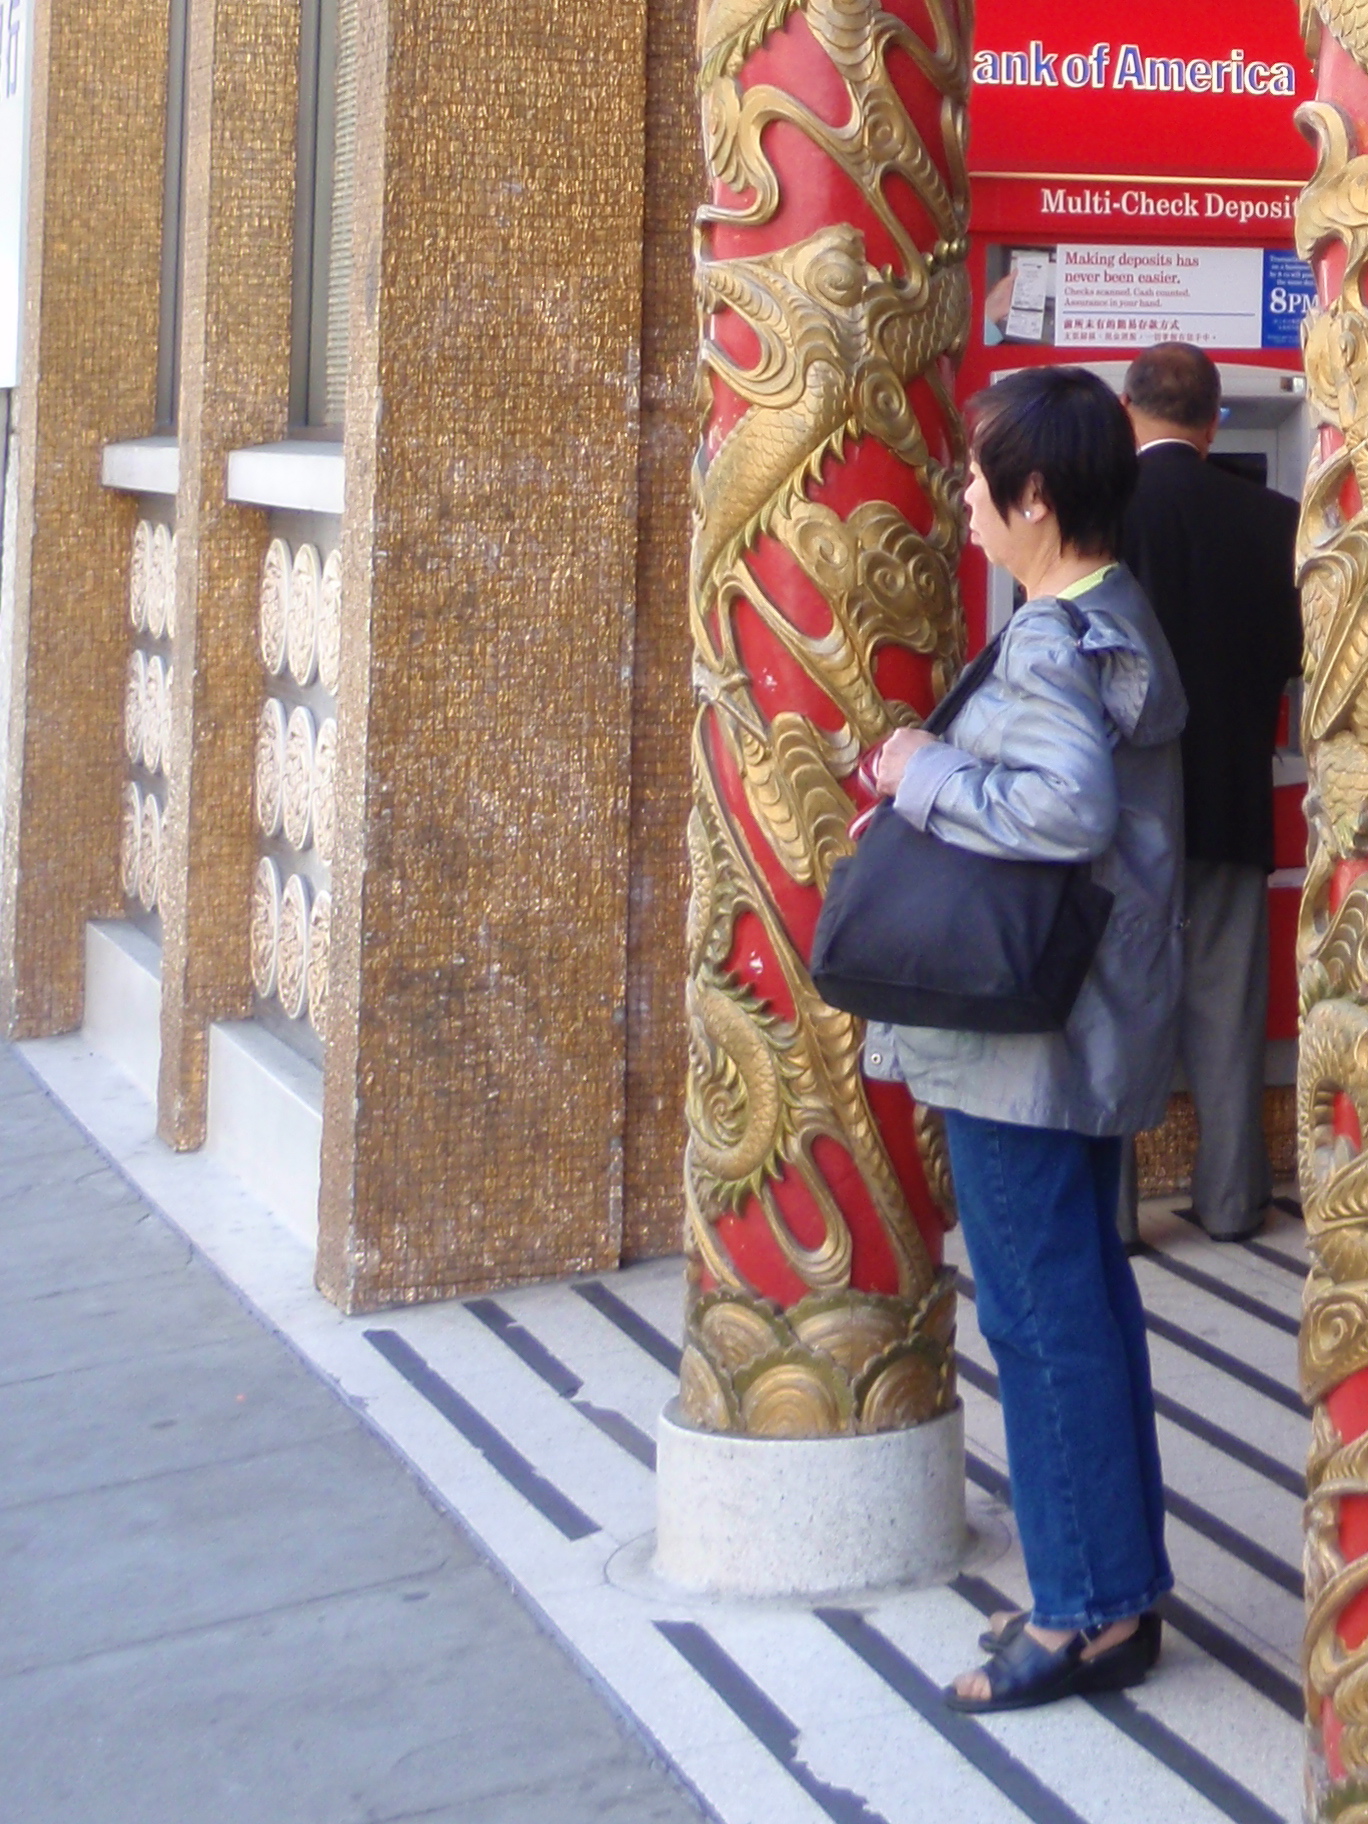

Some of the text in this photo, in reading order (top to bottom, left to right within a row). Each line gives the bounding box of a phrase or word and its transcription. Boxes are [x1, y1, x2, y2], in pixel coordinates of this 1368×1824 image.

[973, 40, 1296, 95] ank of America
[1041, 188, 1199, 217] Multi-Check
[1065, 251, 1199, 268] Making deposits has
[1064, 270, 1181, 284] never been easier.
[1270, 287, 1319, 314] 8PM
